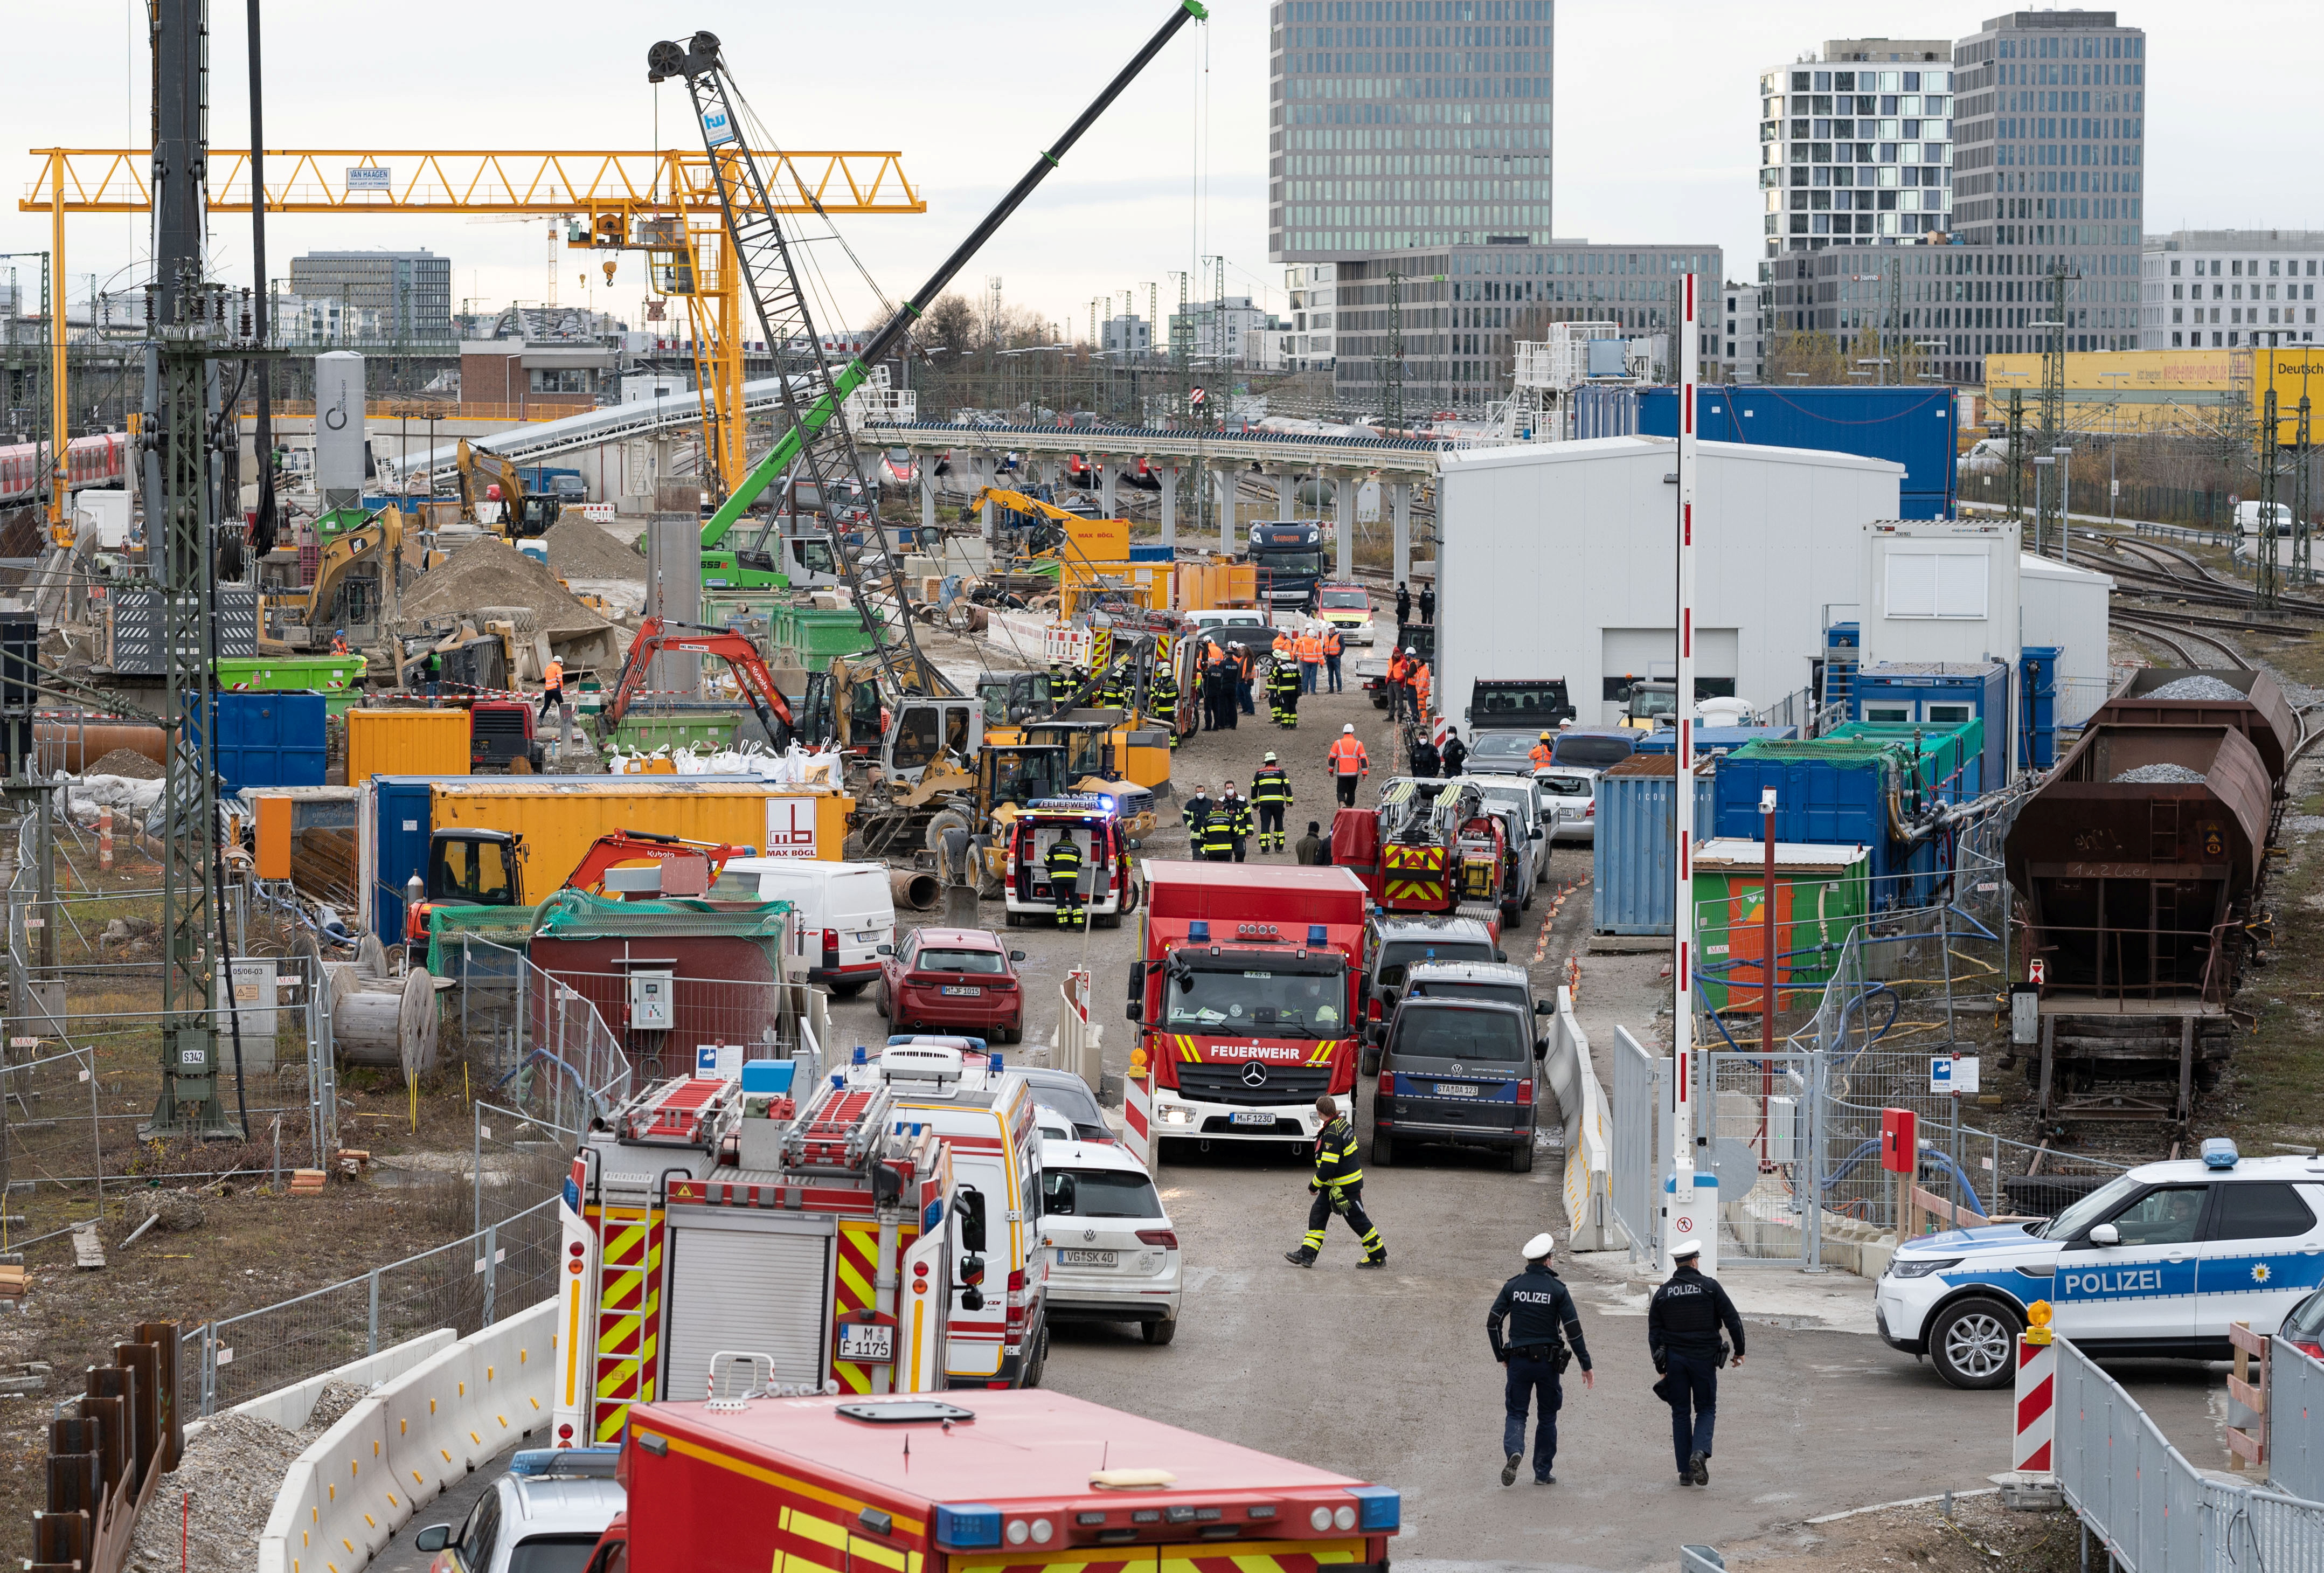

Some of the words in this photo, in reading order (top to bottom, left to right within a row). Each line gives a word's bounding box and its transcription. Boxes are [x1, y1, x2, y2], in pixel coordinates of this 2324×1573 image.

[2278, 363, 2324, 375] Deutsch
[752, 666, 767, 690] Kubota
[792, 848, 815, 856] BÖGL
[15, 1037, 36, 1045] MAC
[184, 1052, 203, 1062] S342
[1211, 1045, 1300, 1059] FEUERWEHR
[1437, 1085, 1450, 1093] STA
[1455, 1085, 1463, 1093] DA
[1465, 1086, 1477, 1094] 123
[1067, 1251, 1081, 1262] VG
[1086, 1252, 1100, 1262] SK
[1101, 1252, 1113, 1263] 40
[2065, 1270, 2161, 1294] POLIZEI
[1668, 1284, 1701, 1297] POLIZEI
[1513, 1291, 1550, 1304] POLIZEI
[864, 1328, 873, 1340] M
[843, 1341, 851, 1353] F
[855, 1341, 889, 1356] 1175
